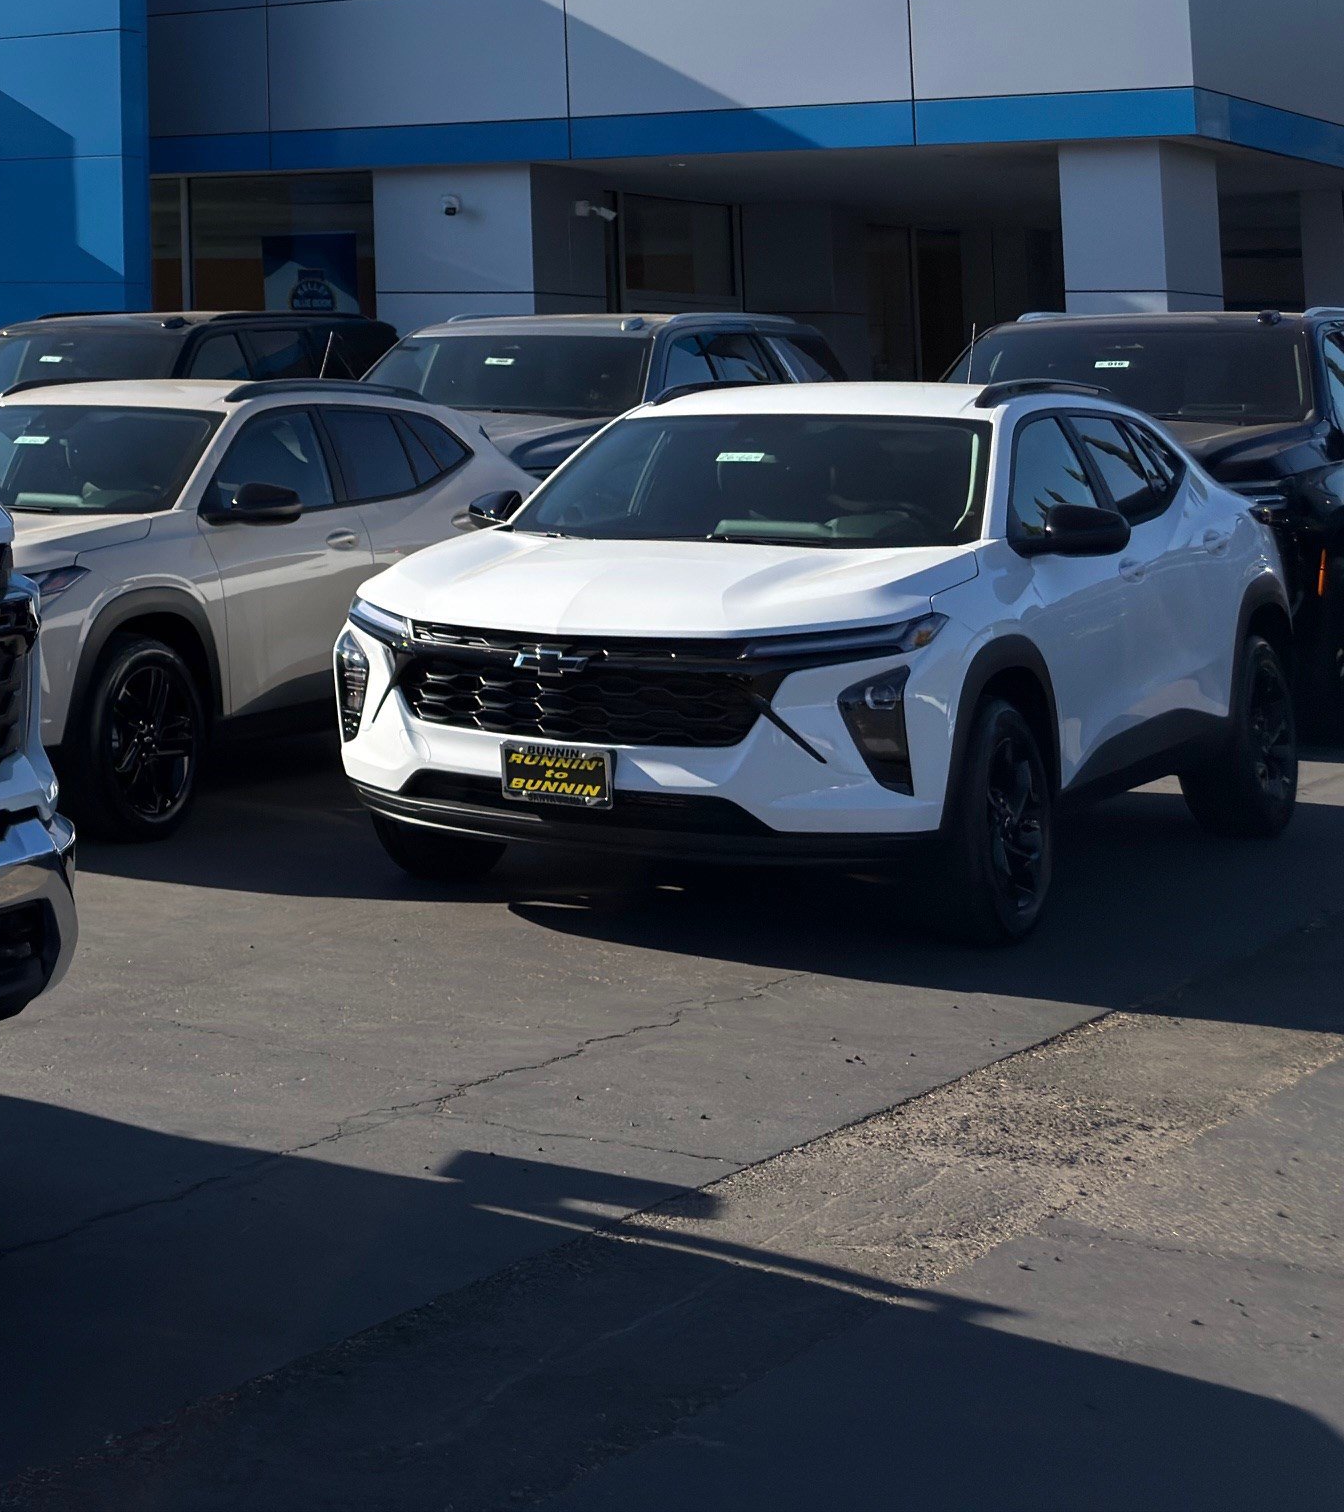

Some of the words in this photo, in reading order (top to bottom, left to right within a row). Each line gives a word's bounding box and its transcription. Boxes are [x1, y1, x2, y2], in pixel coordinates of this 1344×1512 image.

[508, 753, 604, 771] RUNNIN'
[544, 769, 569, 779] to
[509, 777, 601, 796] BUNNIN
